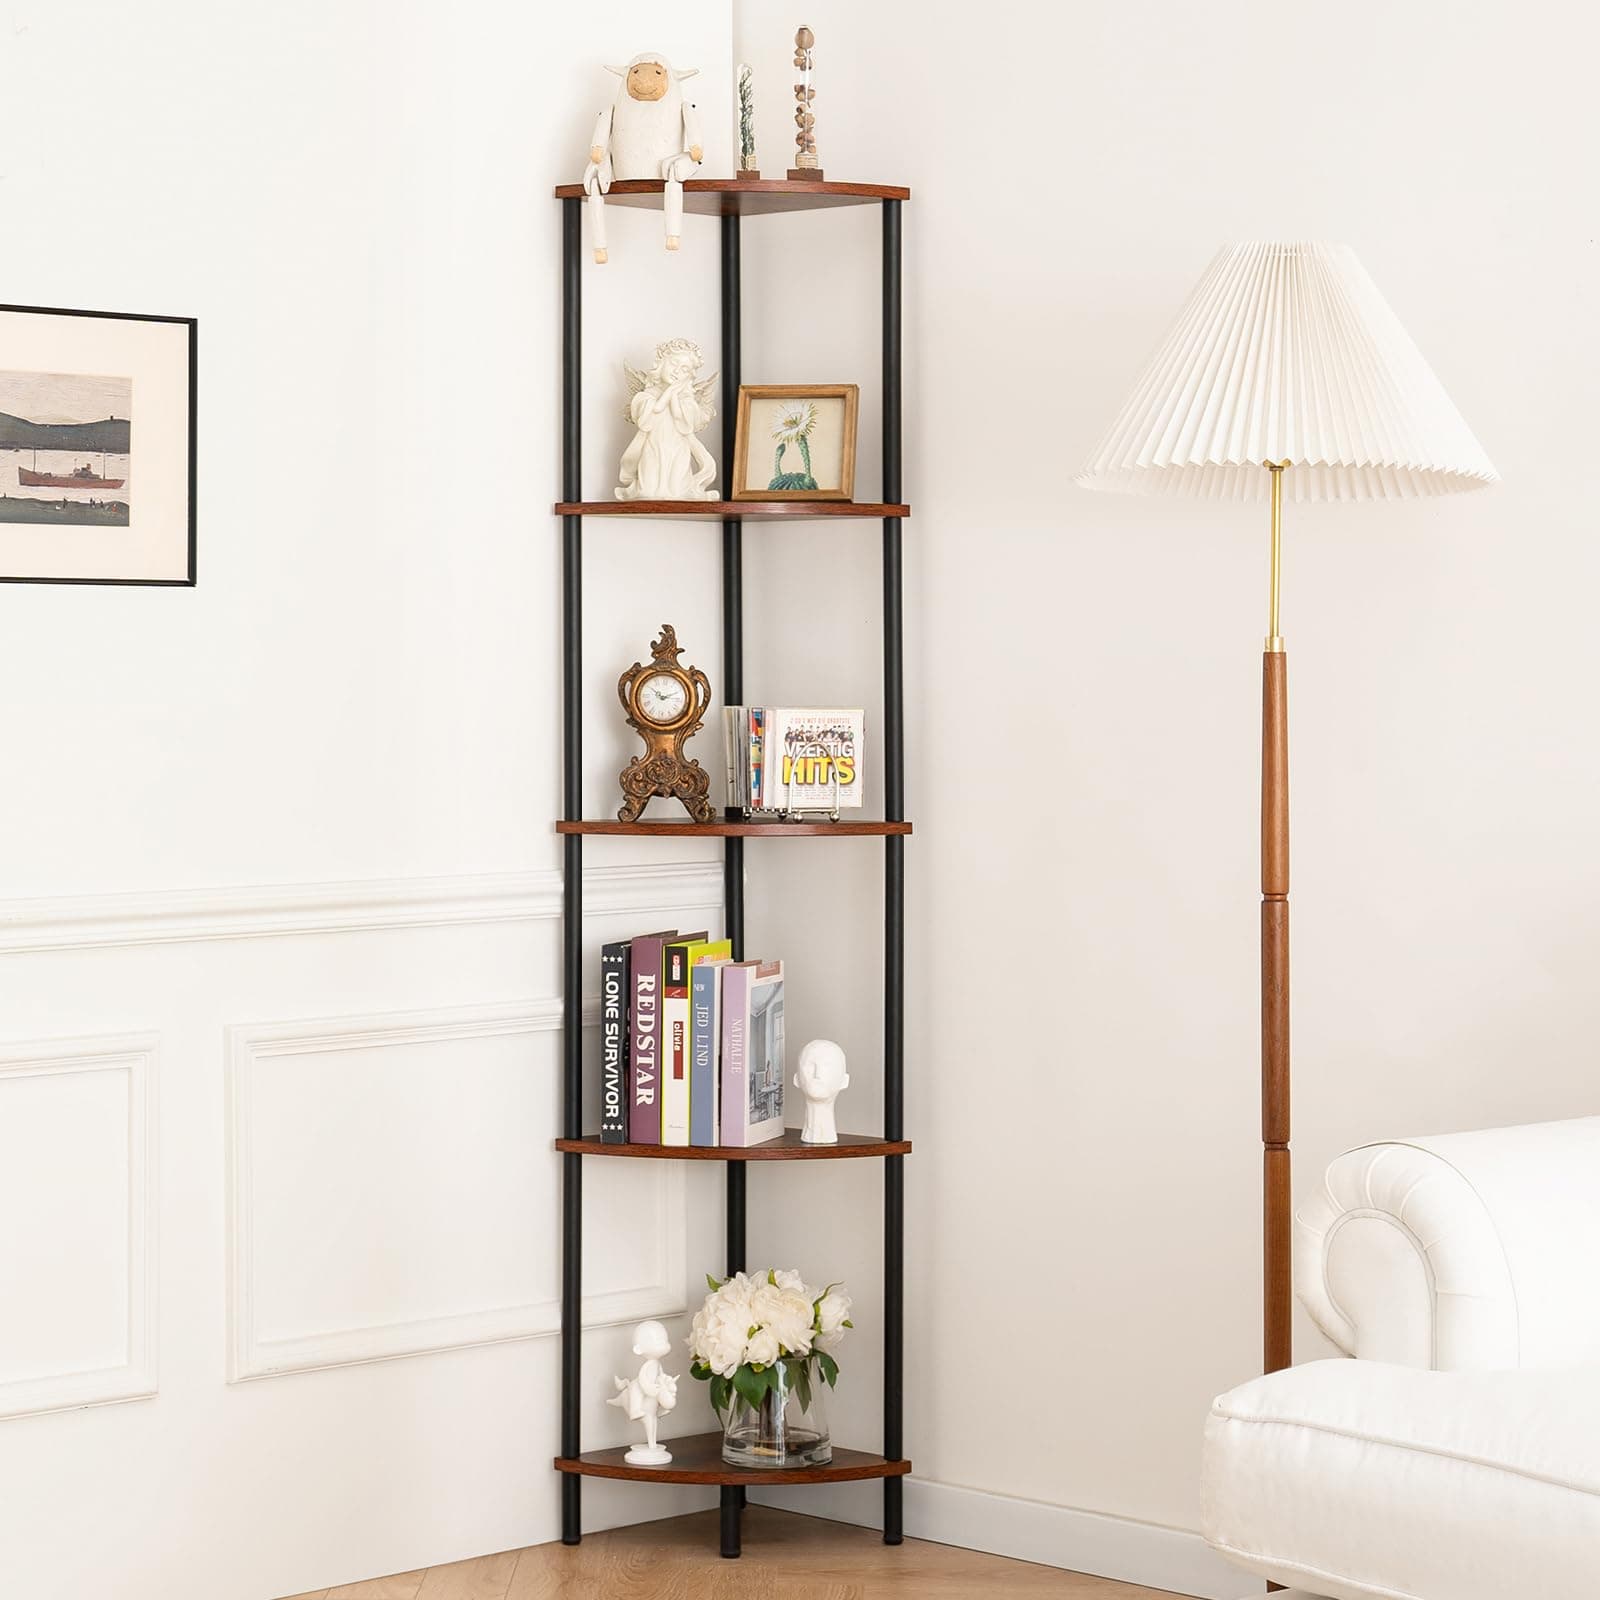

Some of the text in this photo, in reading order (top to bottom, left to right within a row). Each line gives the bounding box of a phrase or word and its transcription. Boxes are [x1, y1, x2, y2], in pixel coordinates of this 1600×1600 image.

[782, 755, 856, 785] HITS
[605, 972, 619, 1118] LONE SURVIVOR
[636, 973, 656, 1106] REDSTAR
[696, 1034, 709, 1066] LIND
